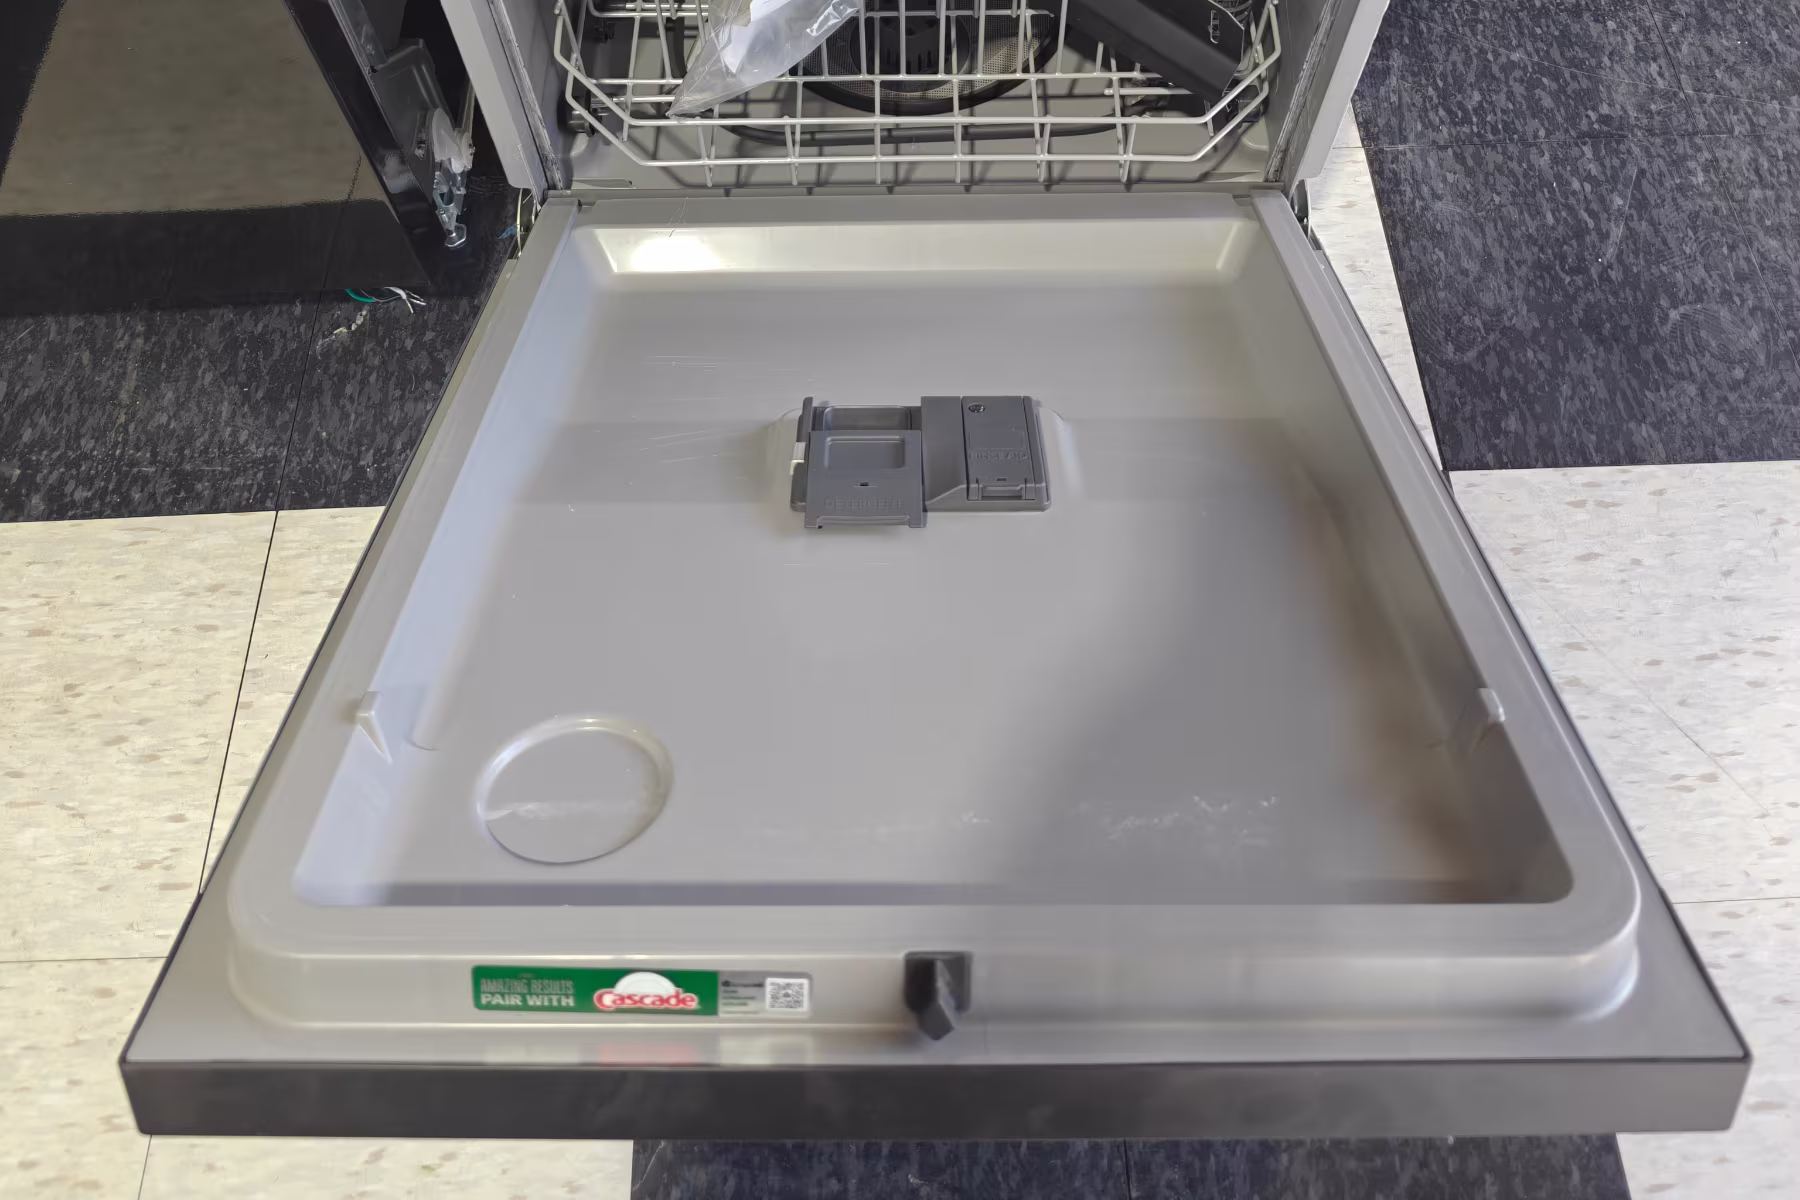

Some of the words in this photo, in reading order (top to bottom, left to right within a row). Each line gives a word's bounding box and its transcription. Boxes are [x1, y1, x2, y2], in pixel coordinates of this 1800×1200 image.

[480, 978, 528, 994] AMAZING
[531, 979, 575, 995] RESULTS
[480, 993, 523, 1006] PAIR
[526, 994, 576, 1007] WITH
[594, 987, 699, 1011] Cascade
